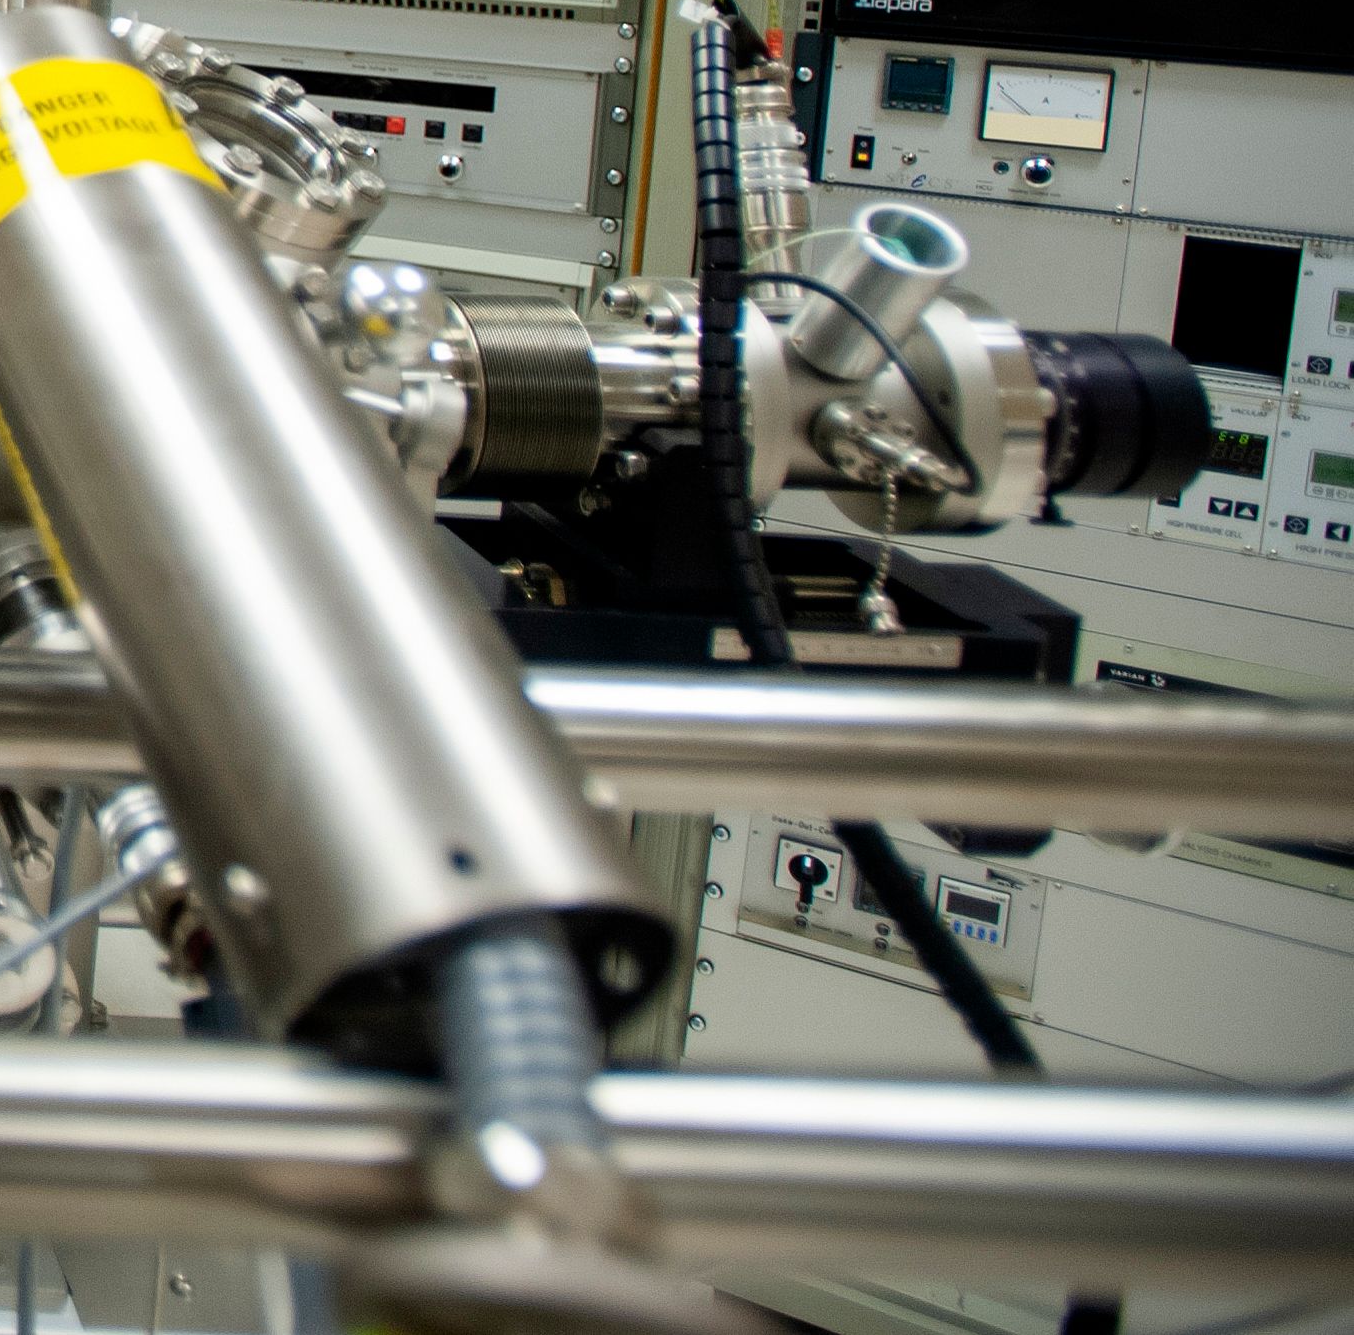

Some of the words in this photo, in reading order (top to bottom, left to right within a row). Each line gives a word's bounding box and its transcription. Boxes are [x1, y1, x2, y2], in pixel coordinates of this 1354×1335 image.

[1042, 97, 1050, 105] A
[1291, 376, 1320, 387] LOAD
[1322, 379, 1351, 391] LOCK
